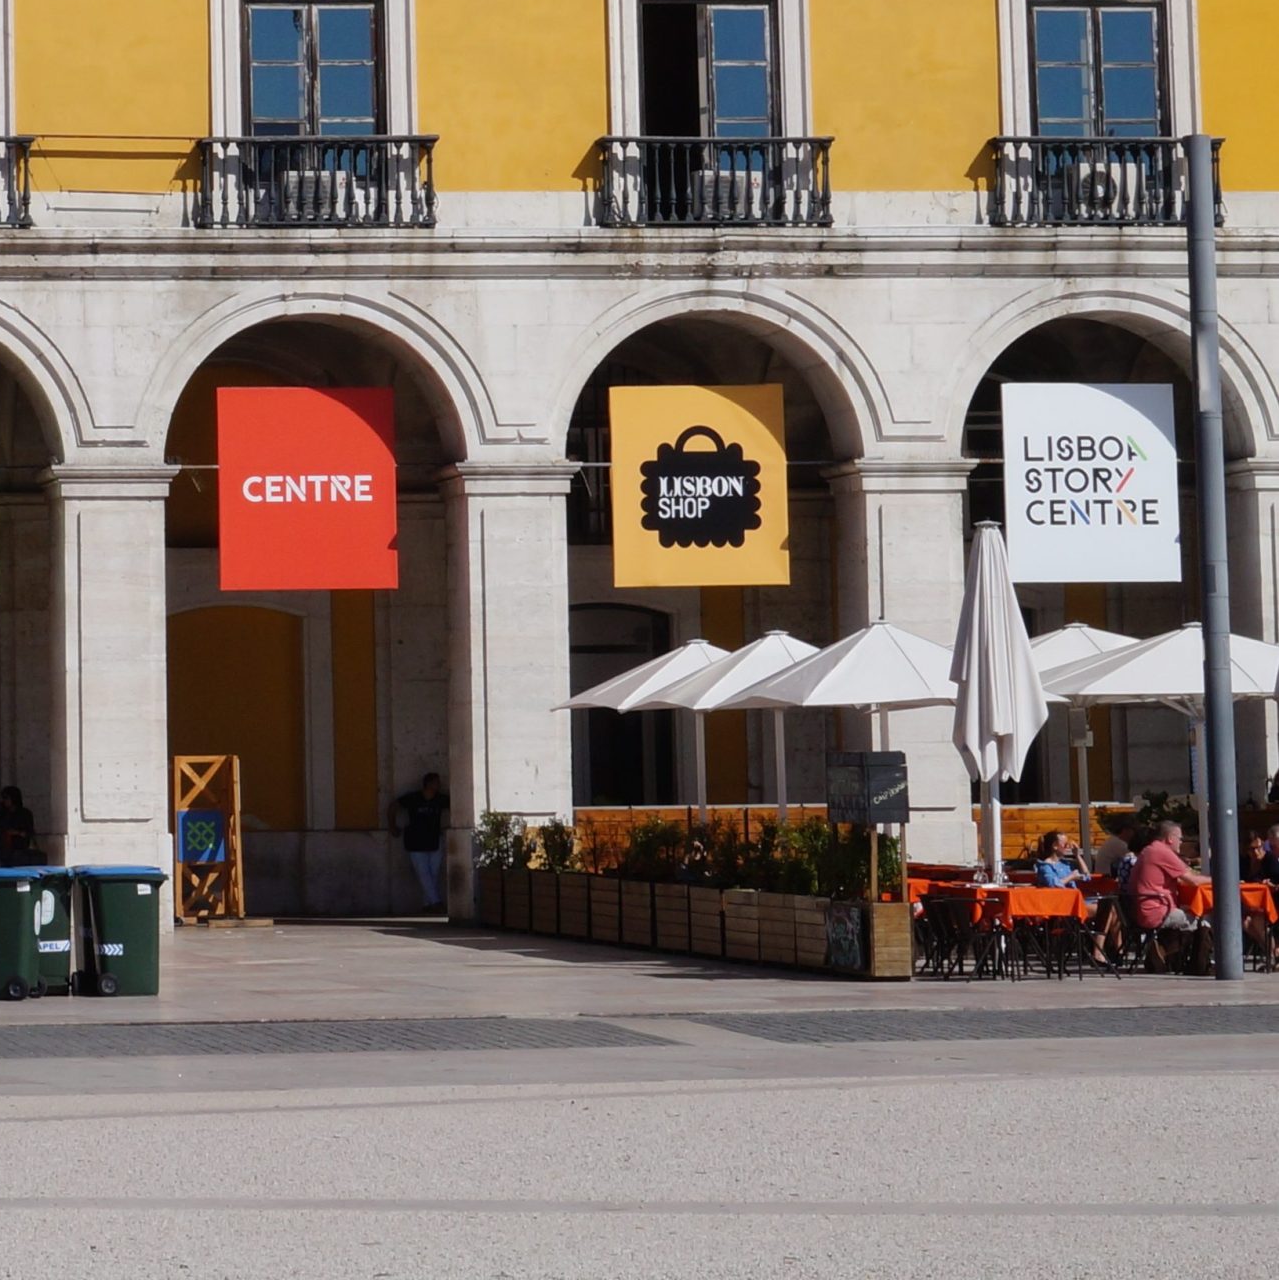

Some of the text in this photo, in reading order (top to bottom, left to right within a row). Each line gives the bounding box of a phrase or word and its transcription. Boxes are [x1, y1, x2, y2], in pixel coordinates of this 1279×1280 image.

[1023, 435, 1148, 462] LISBOA
[242, 474, 373, 503] CENTRE
[659, 475, 744, 498] LISBON
[1024, 467, 1135, 494] STORY
[658, 497, 710, 519] SHOP
[1025, 499, 1160, 526] CENTRE
